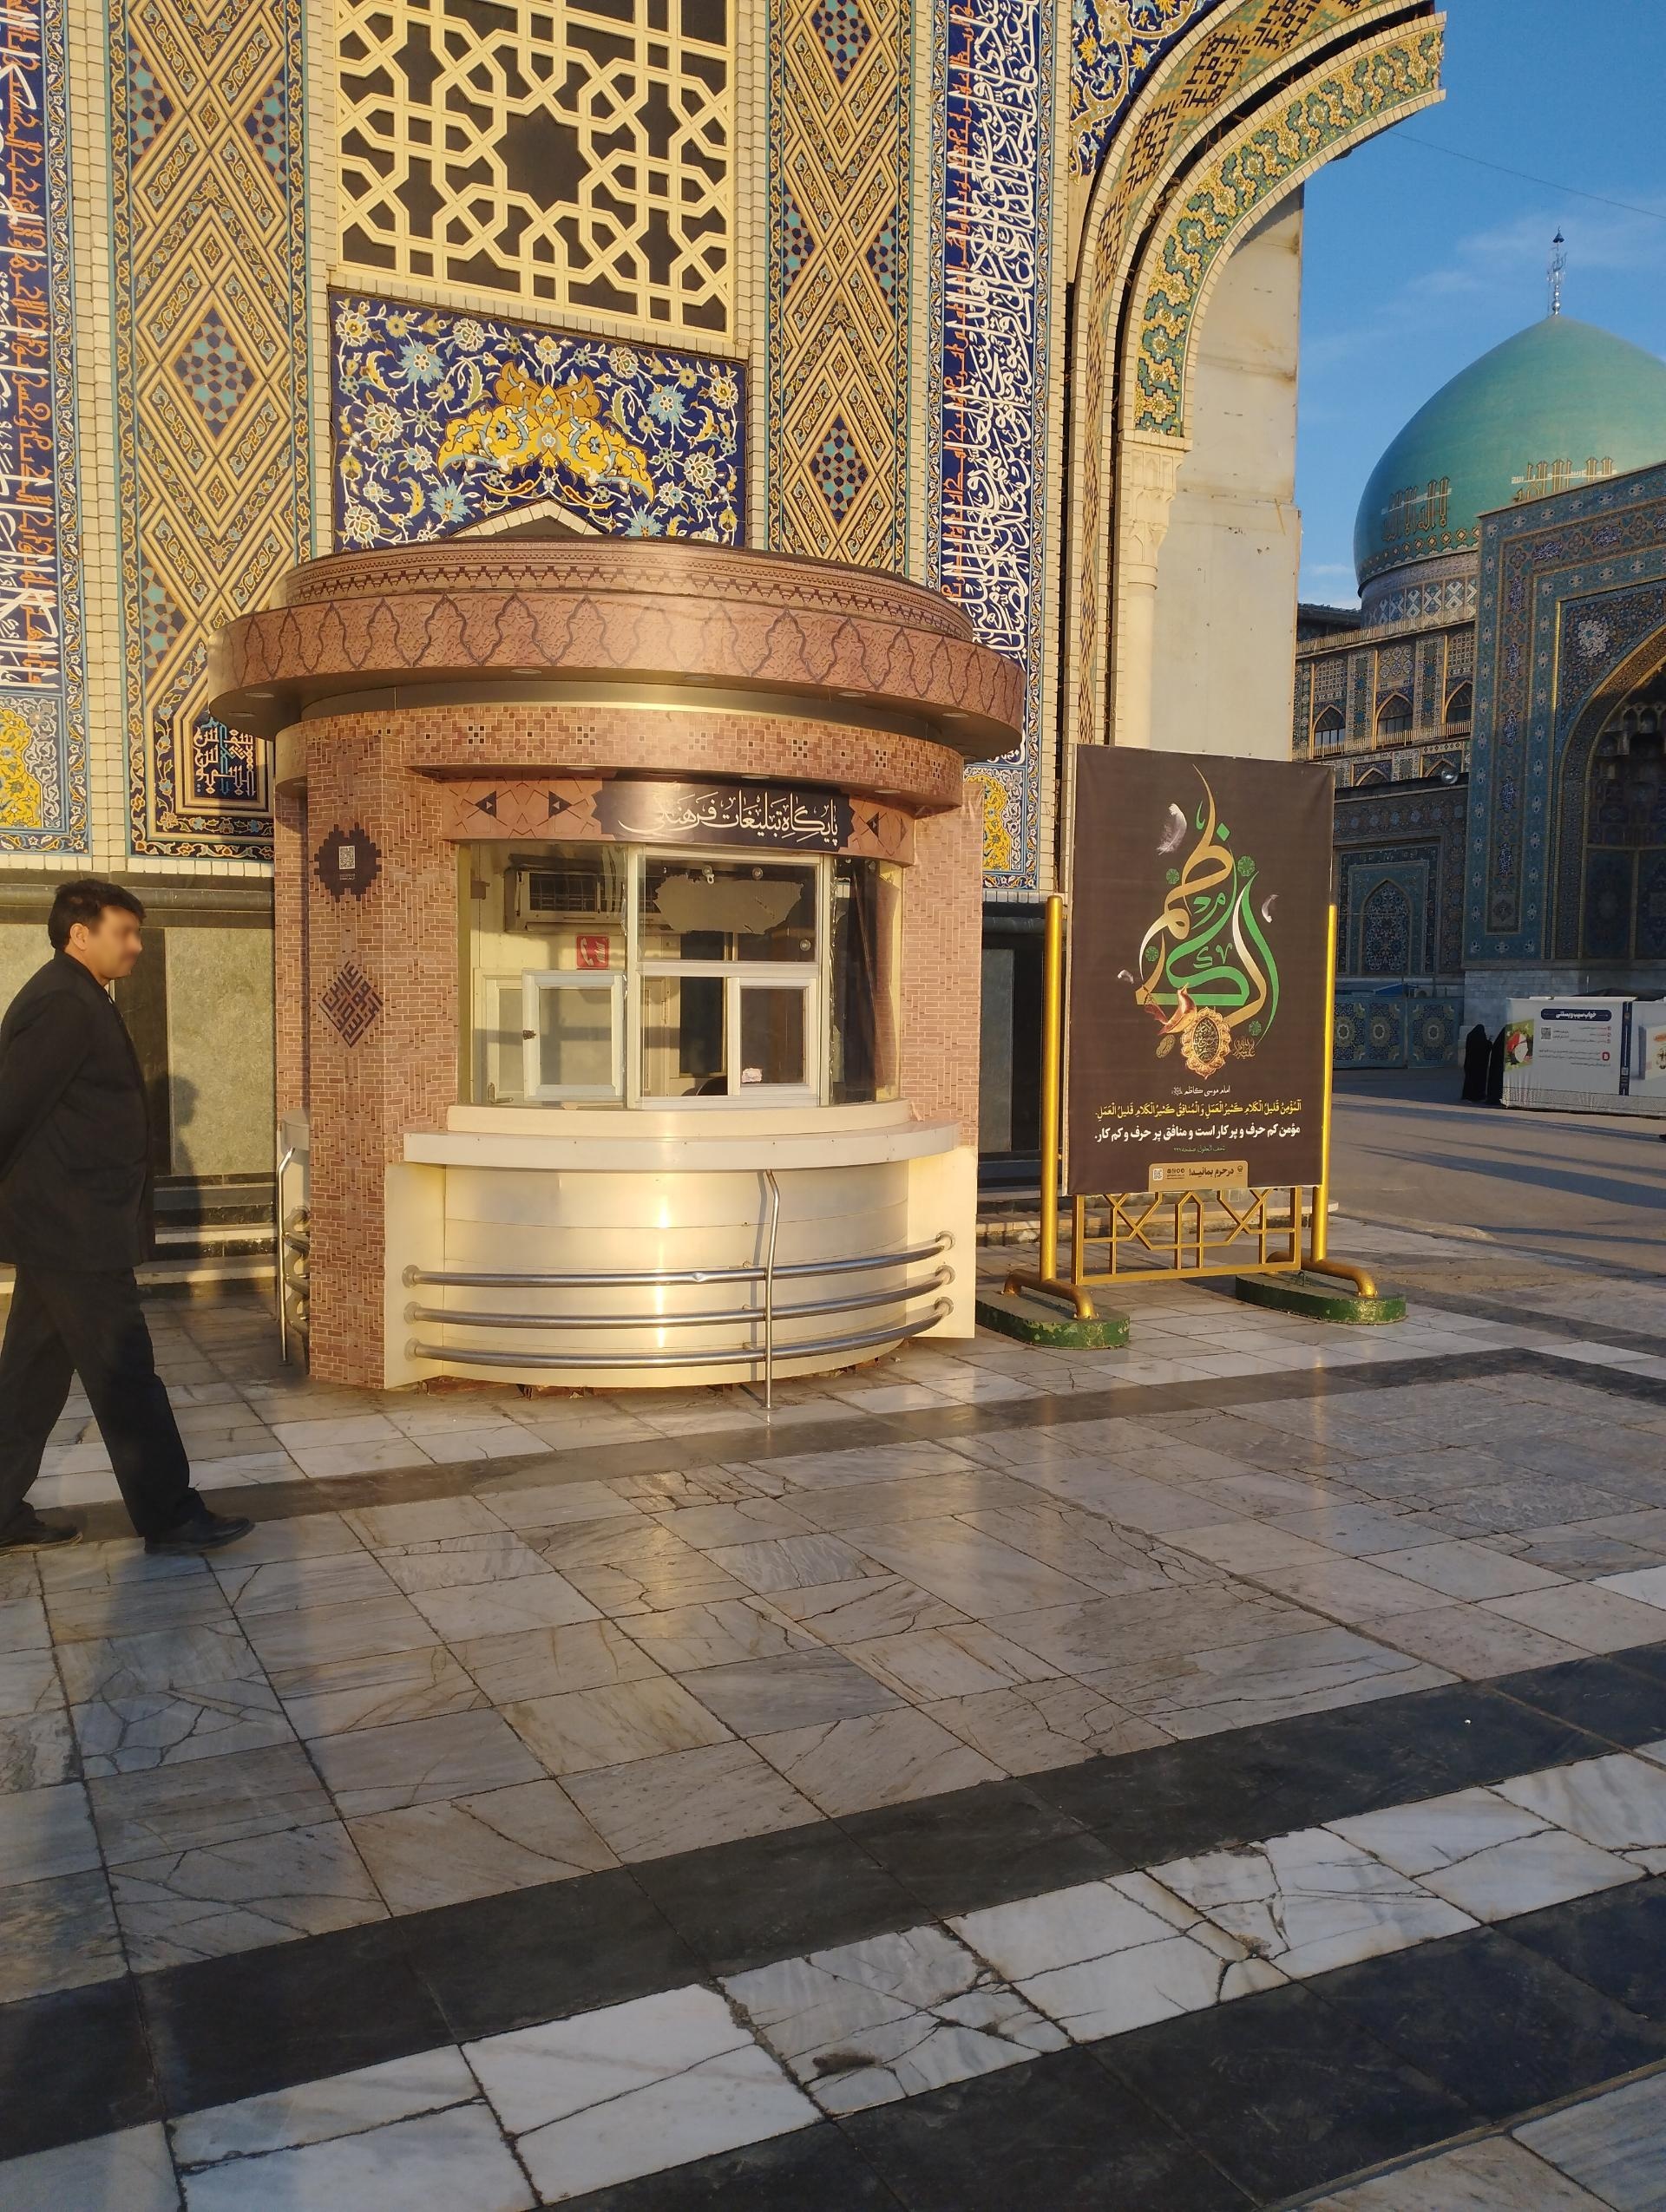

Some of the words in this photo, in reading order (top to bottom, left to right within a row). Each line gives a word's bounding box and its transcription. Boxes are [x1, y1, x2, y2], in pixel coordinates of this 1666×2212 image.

[700, 789, 786, 837] تبلیغات
[781, 791, 839, 847] پایگاه
[1204, 1088, 1219, 1096] موسی
[1220, 1084, 1230, 1094] امام
[1111, 1127, 1124, 1142] کم
[1130, 1125, 1151, 1142] حرف
[1152, 1129, 1162, 1142] پر
[1163, 1124, 1187, 1141] منافق
[1188, 1129, 1194, 1140] و
[1195, 1125, 1215, 1136] است
[1216, 1124, 1230, 1139] کار
[1229, 1128, 1238, 1139] پر
[1238, 1128, 1244, 1138] و
[1245, 1122, 1266, 1138] حرف
[1267, 1123, 1279, 1137] کم
[1278, 1122, 1301, 1137] مؤمن
